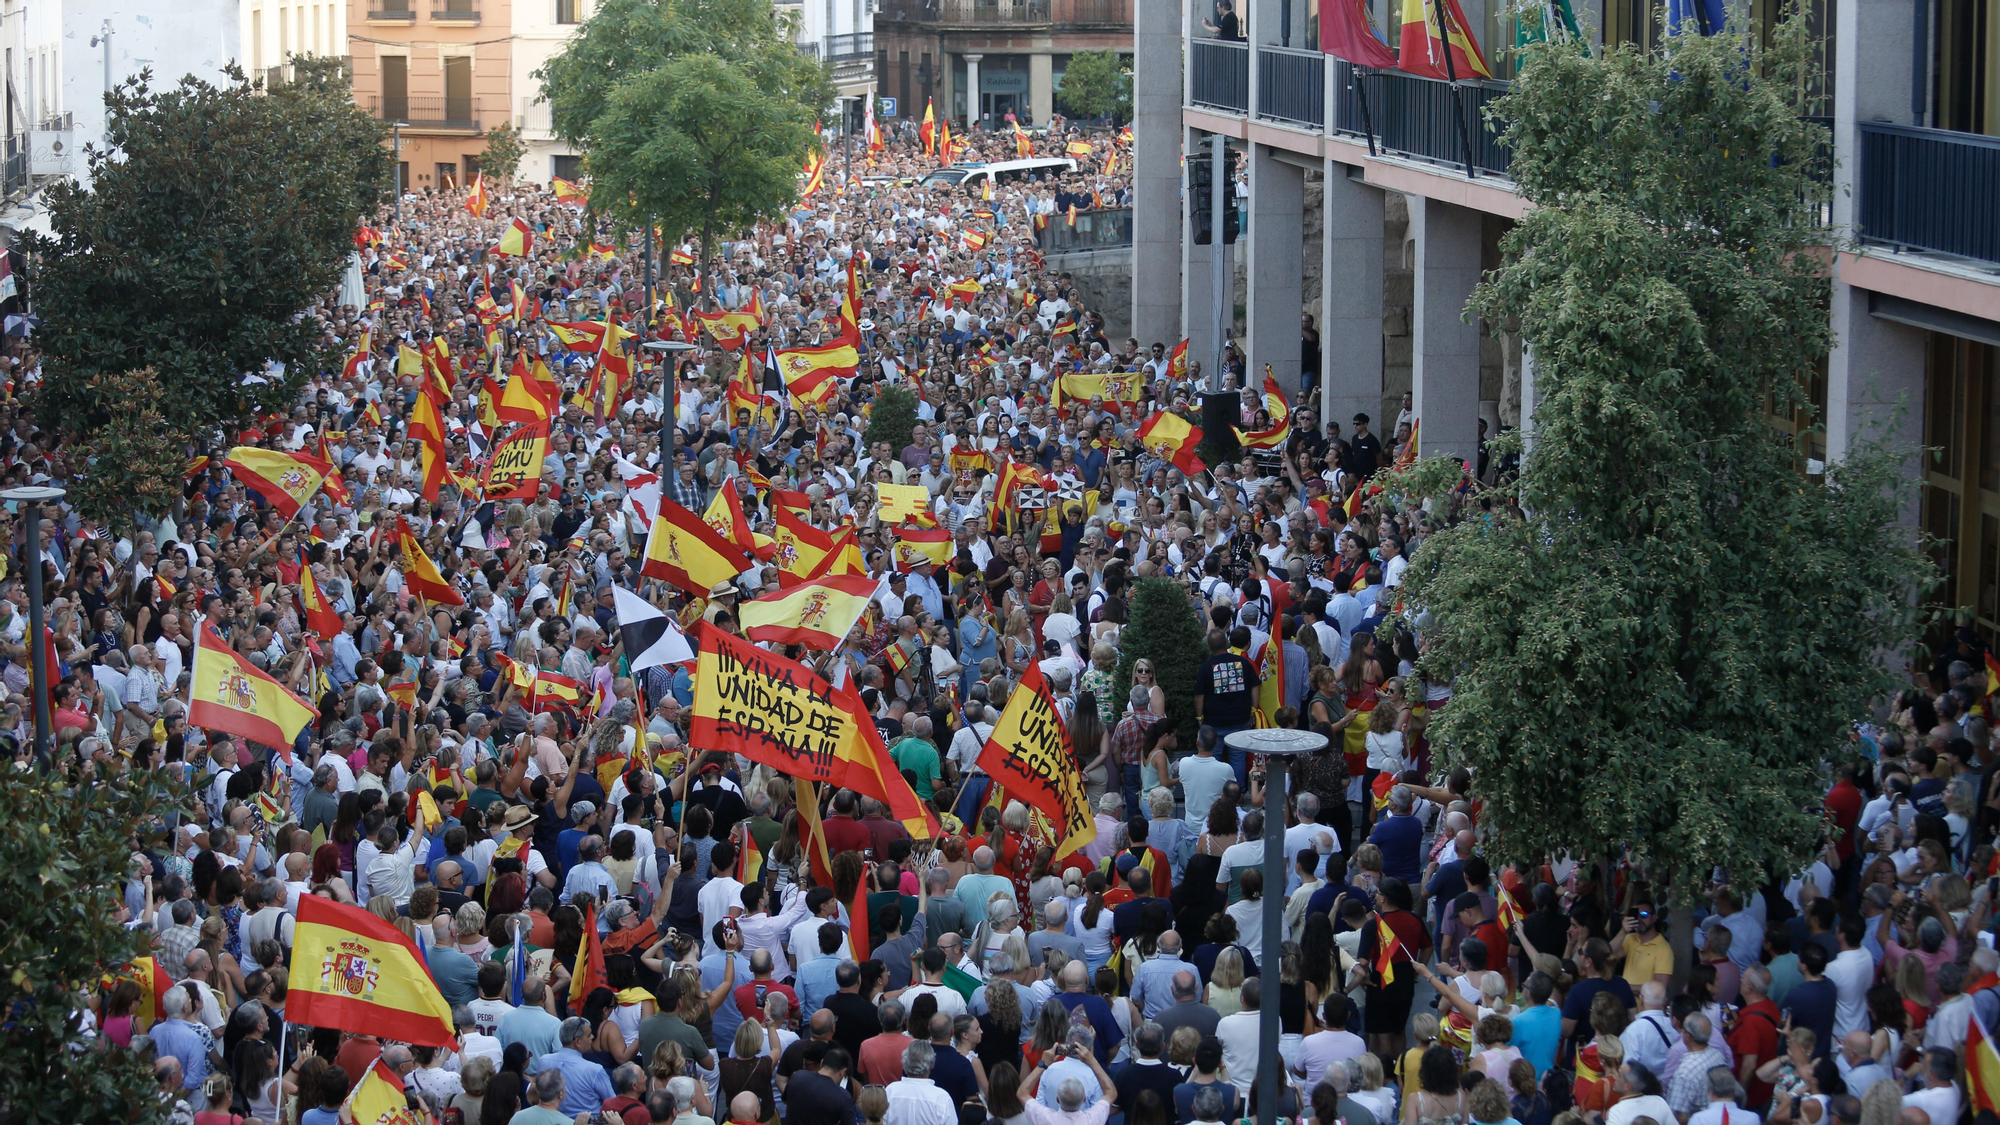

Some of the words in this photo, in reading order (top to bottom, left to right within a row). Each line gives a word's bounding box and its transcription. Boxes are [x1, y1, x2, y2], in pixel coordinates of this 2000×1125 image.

[807, 677, 833, 709] LA
[806, 708, 845, 739] DE
[715, 705, 837, 777] ESPAÑA!!!
[477, 1013, 494, 1022] PEDRI
